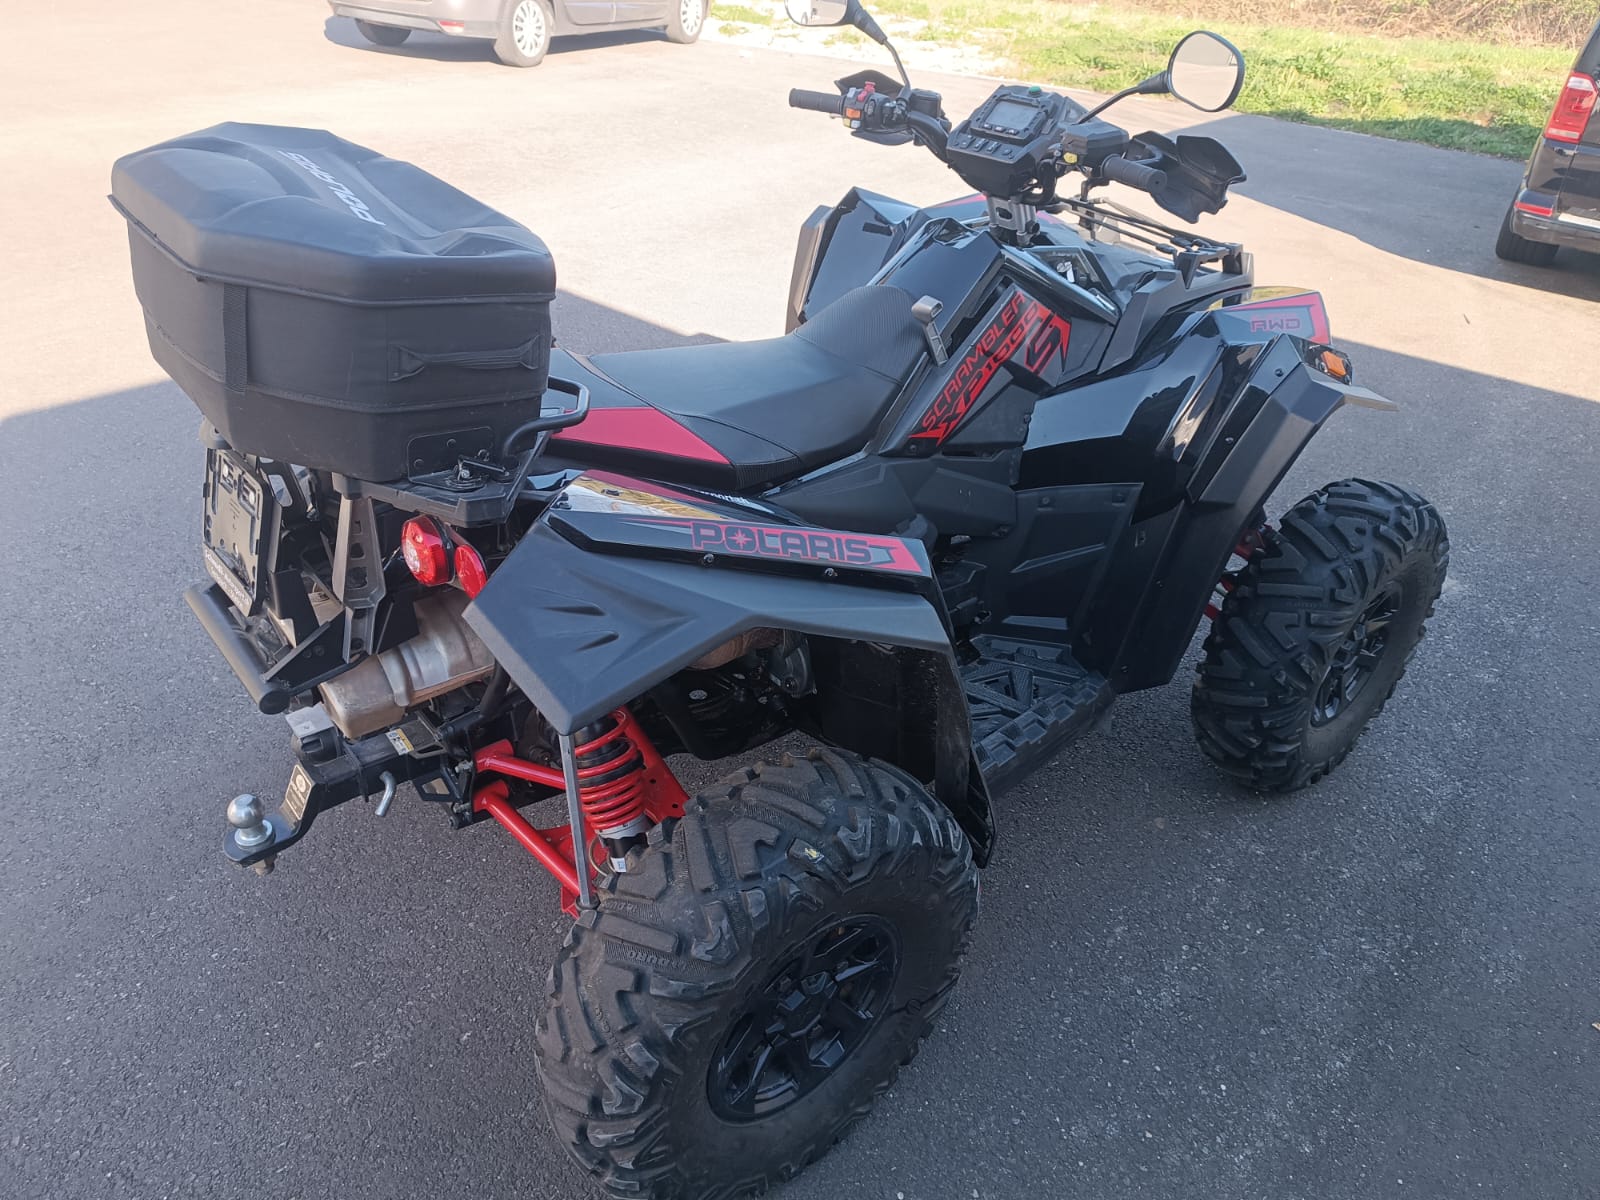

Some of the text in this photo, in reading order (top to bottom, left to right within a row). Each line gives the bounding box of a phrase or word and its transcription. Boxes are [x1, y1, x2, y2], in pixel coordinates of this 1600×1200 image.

[1250, 317, 1300, 333] AWD
[922, 290, 1026, 431] SCRAMBLER
[690, 521, 873, 566] POLARIS
